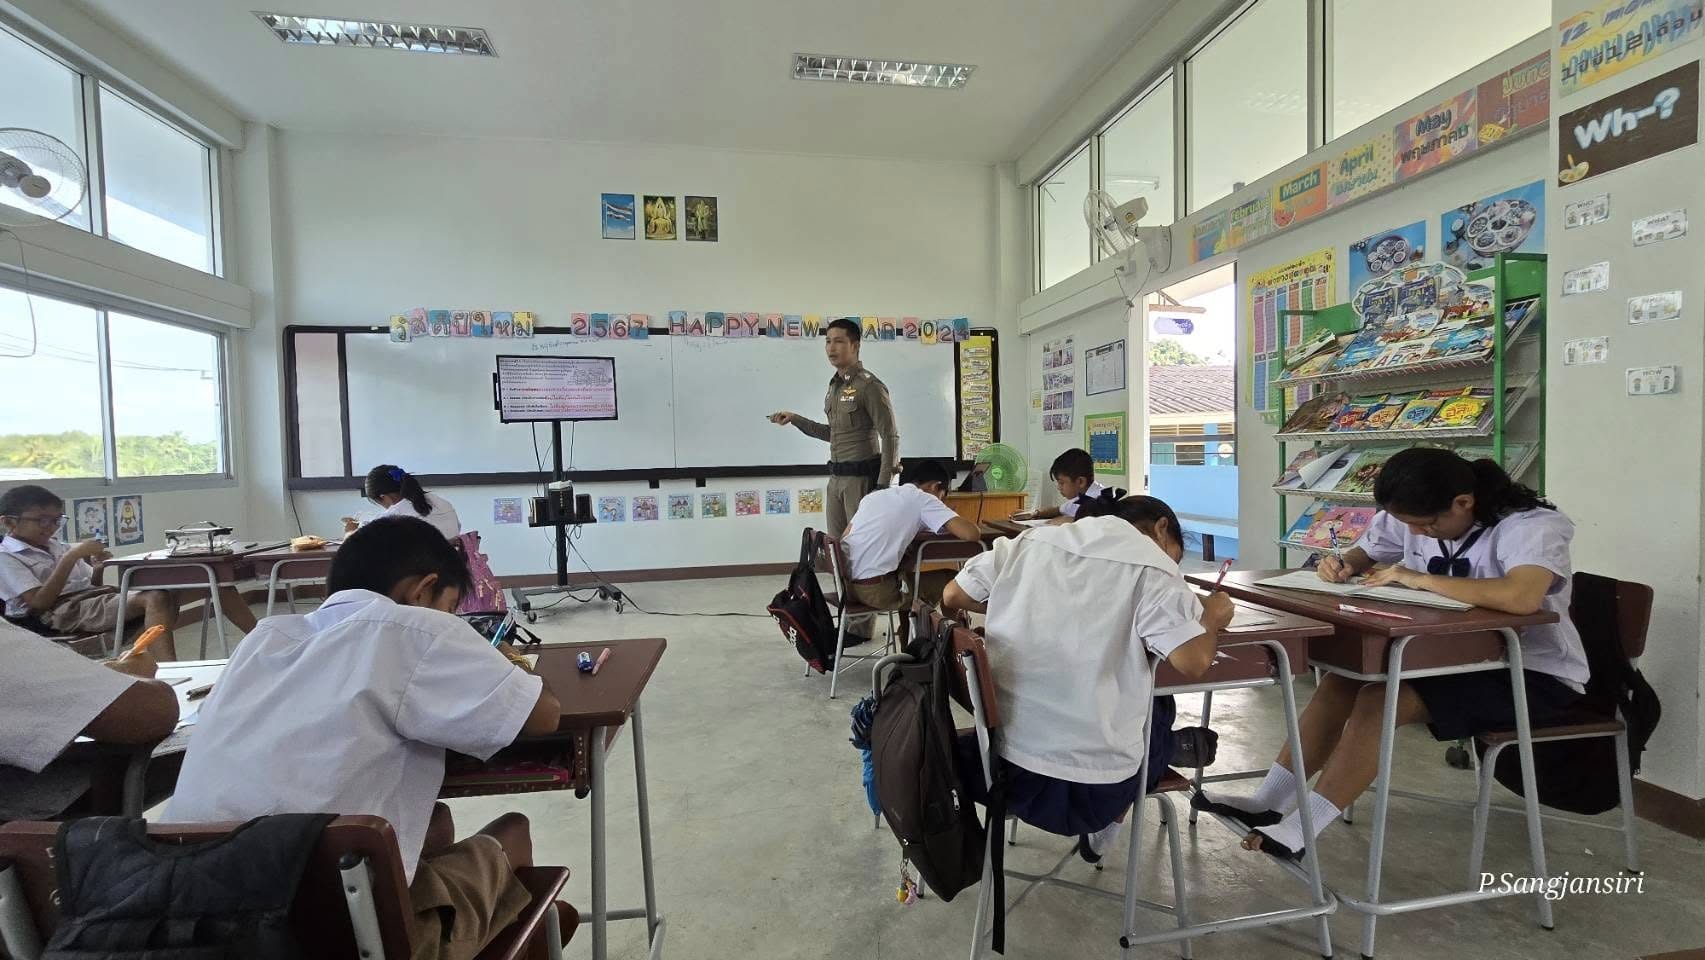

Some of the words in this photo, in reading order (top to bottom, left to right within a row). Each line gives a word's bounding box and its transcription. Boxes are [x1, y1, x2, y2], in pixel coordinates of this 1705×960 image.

[1416, 99, 1452, 136] May
[1339, 144, 1374, 175] April
[1282, 171, 1318, 199] March
[572, 316, 644, 338] 2567
[669, 311, 759, 337] HAPPY
[767, 317, 820, 339] NEW
[904, 320, 969, 343] 2024
